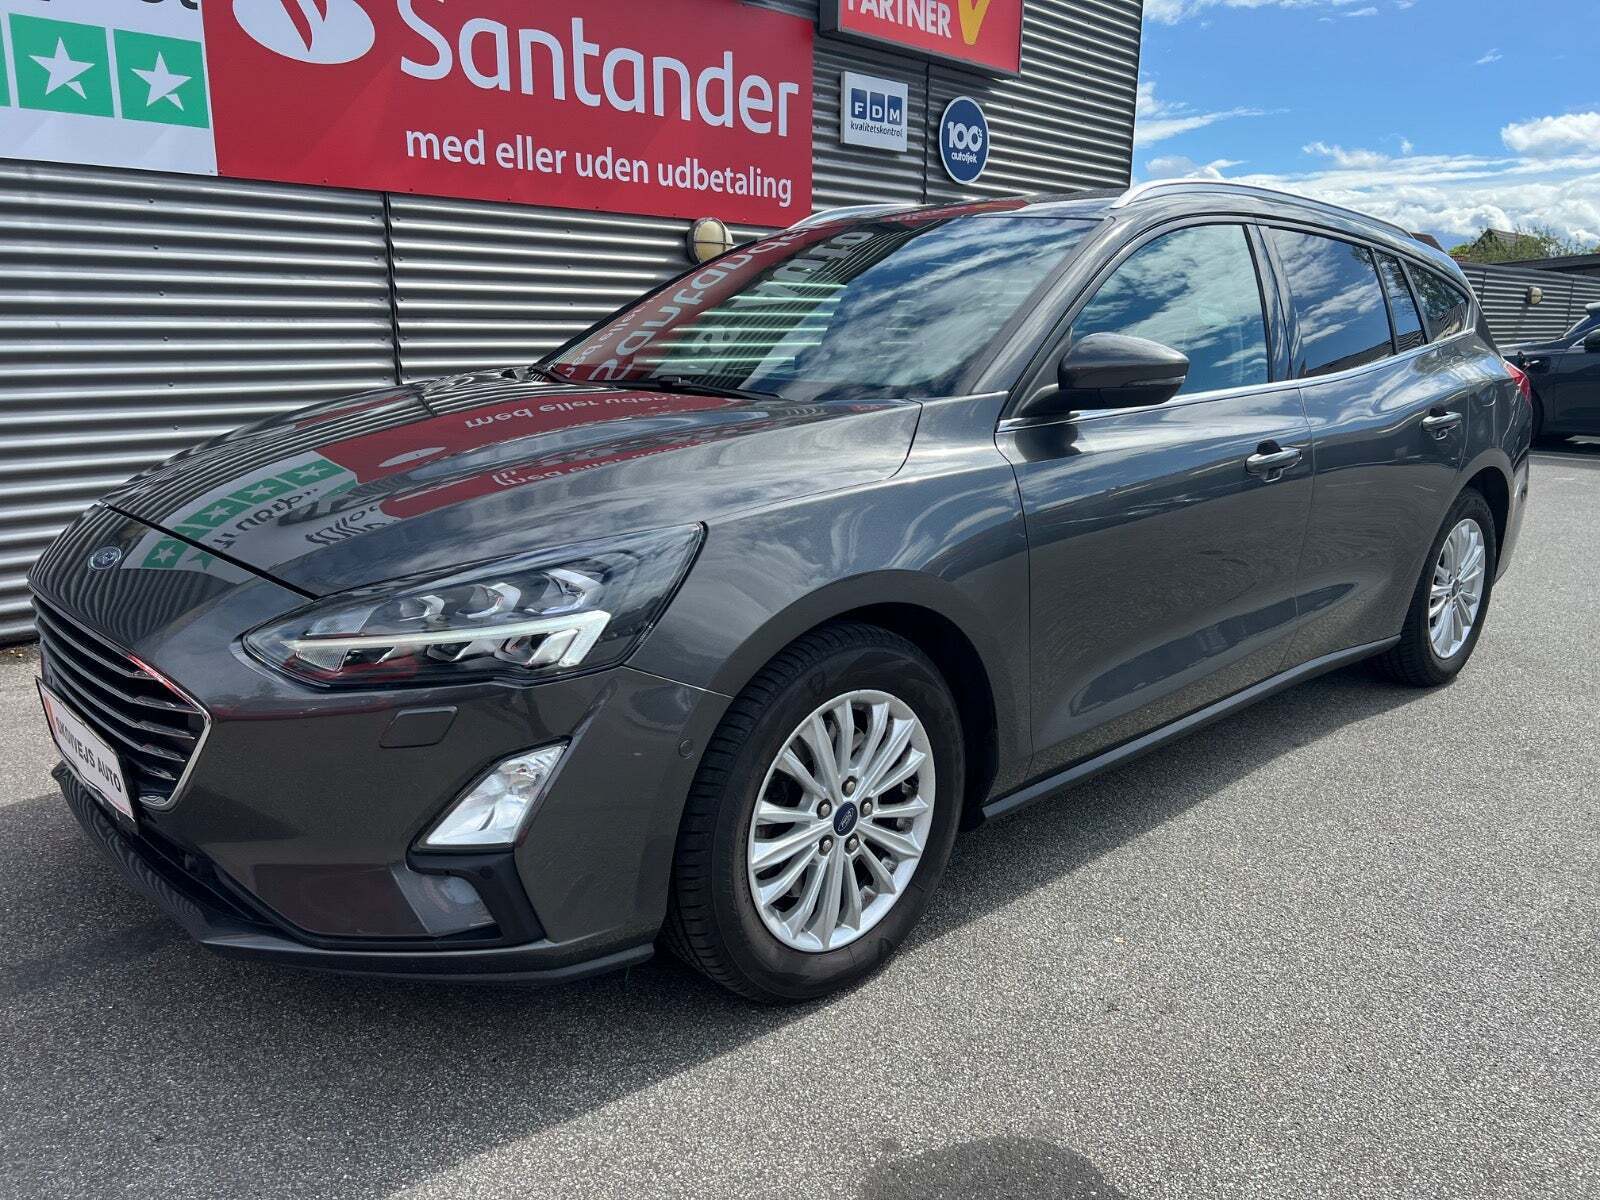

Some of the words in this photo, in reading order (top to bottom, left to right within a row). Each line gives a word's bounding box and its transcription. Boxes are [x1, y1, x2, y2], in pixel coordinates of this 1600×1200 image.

[396, 0, 799, 137] Santander
[850, 121, 904, 138] kvalitetskontrol
[853, 101, 901, 123] FDM
[406, 128, 486, 166] med
[495, 134, 567, 174] eller
[575, 146, 649, 184] uden
[657, 157, 793, 208] udbetaling
